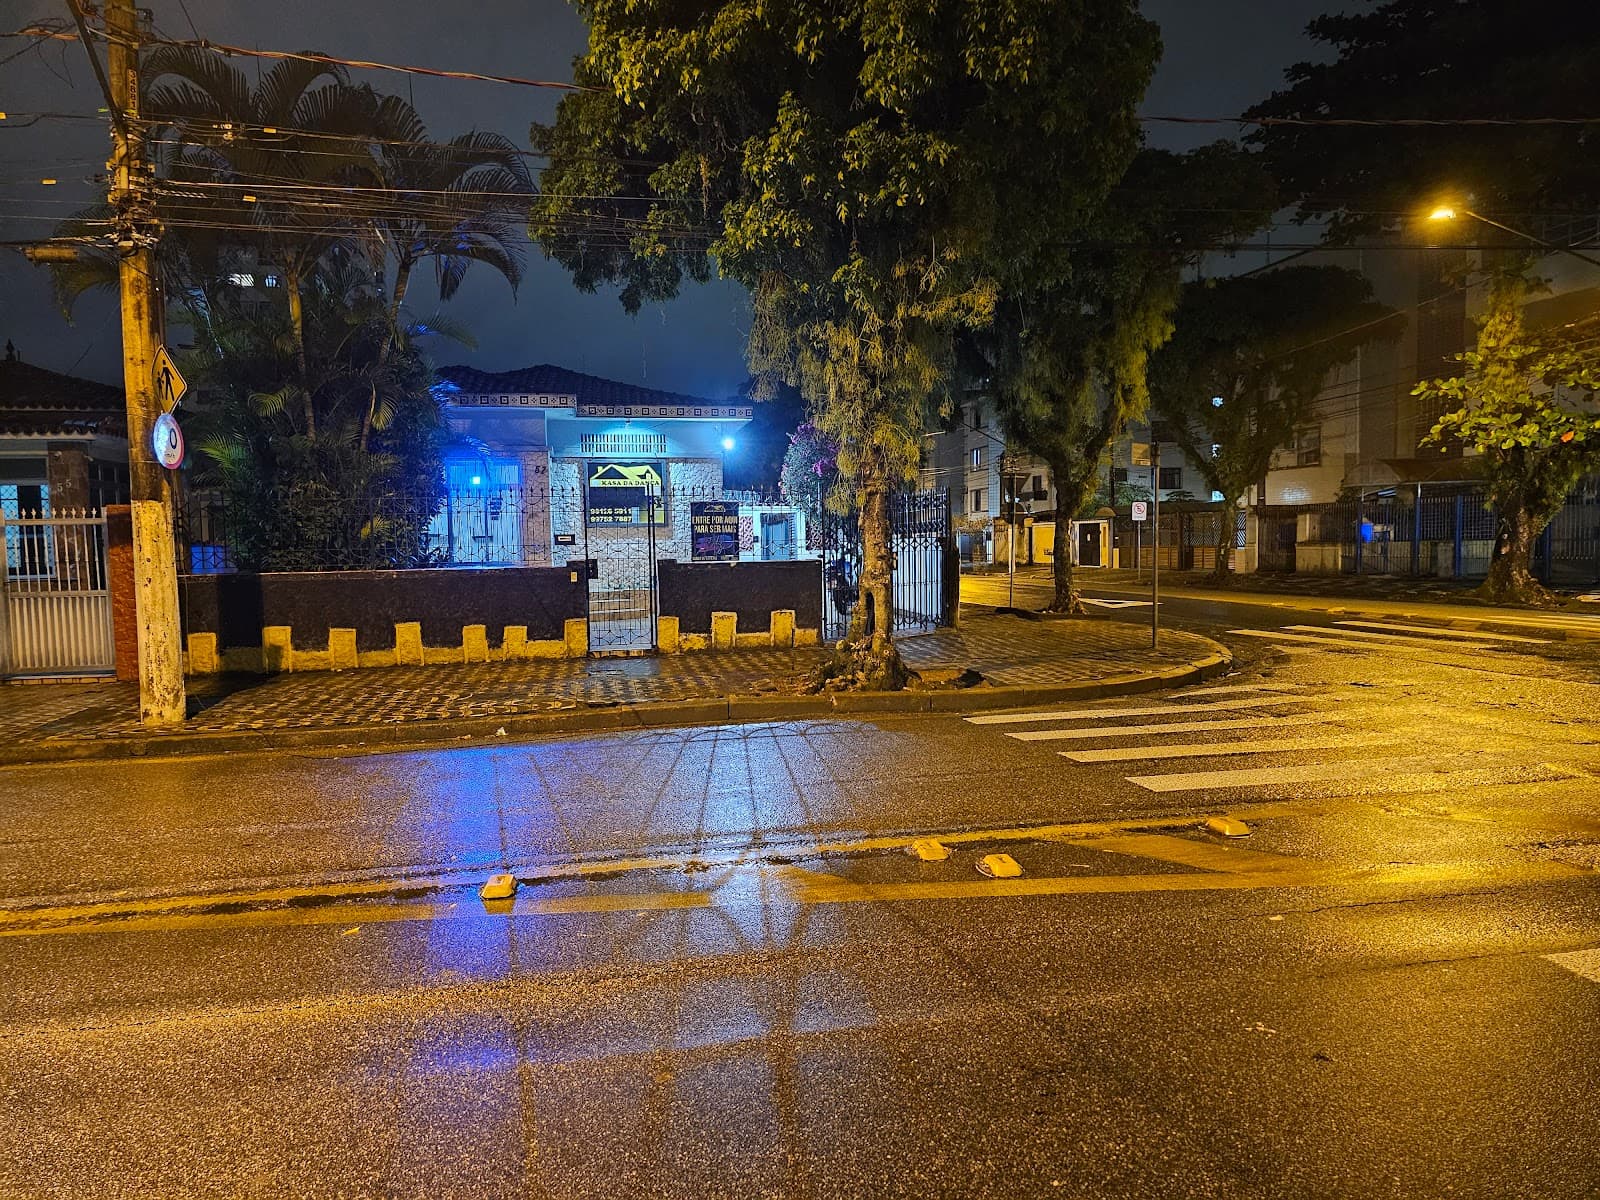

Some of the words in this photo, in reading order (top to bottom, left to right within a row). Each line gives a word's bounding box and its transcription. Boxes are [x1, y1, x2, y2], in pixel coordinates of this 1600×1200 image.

[692, 516, 710, 524] ENTRE
[711, 516, 724, 524] POR
[694, 525, 709, 533] PARA
[710, 525, 722, 533] SER
